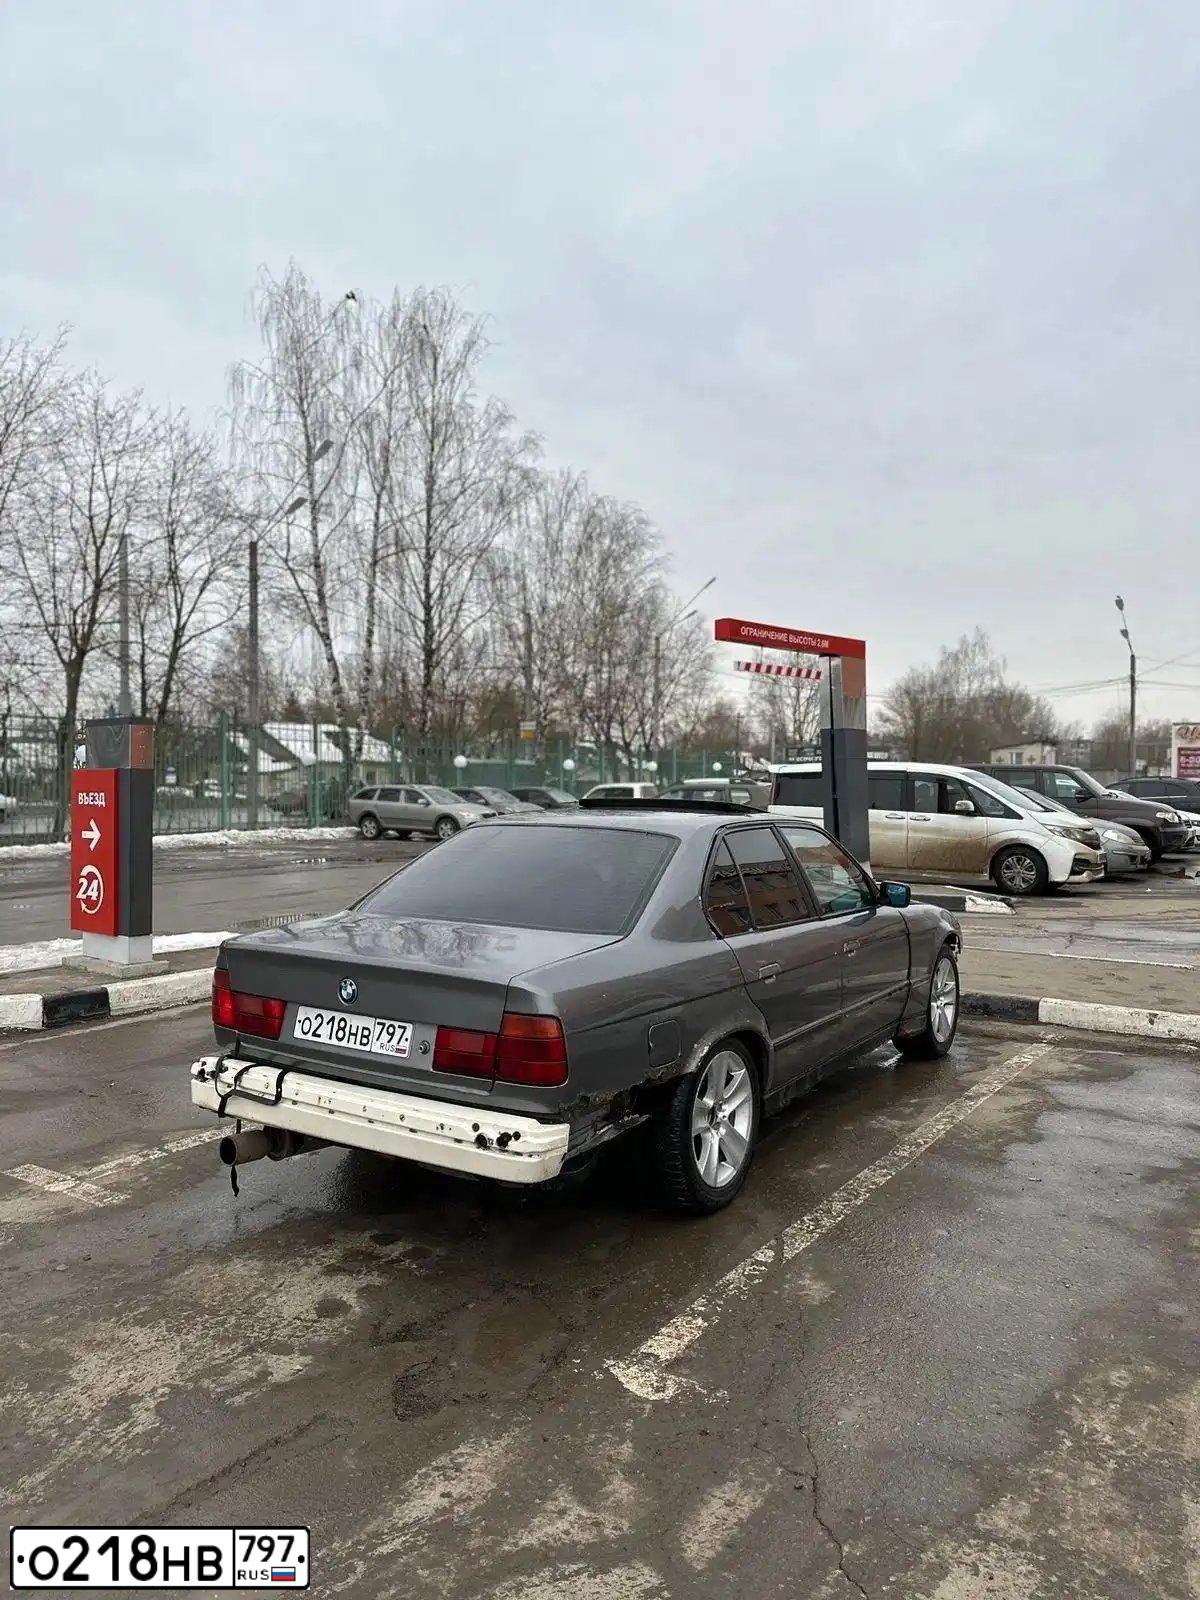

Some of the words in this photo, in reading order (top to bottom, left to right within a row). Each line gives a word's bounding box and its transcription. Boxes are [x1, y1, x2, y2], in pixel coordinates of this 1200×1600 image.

[740, 626, 788, 642] ОГРАНИЧЕНИЕ
[789, 634, 817, 646] ВЫСОТЫ
[78, 792, 105, 807] ВЪЕЗД
[76, 877, 99, 900] 24
[301, 1013, 371, 1046] О218НВ
[376, 1022, 407, 1044] 797
[380, 1042, 395, 1053] RUS
